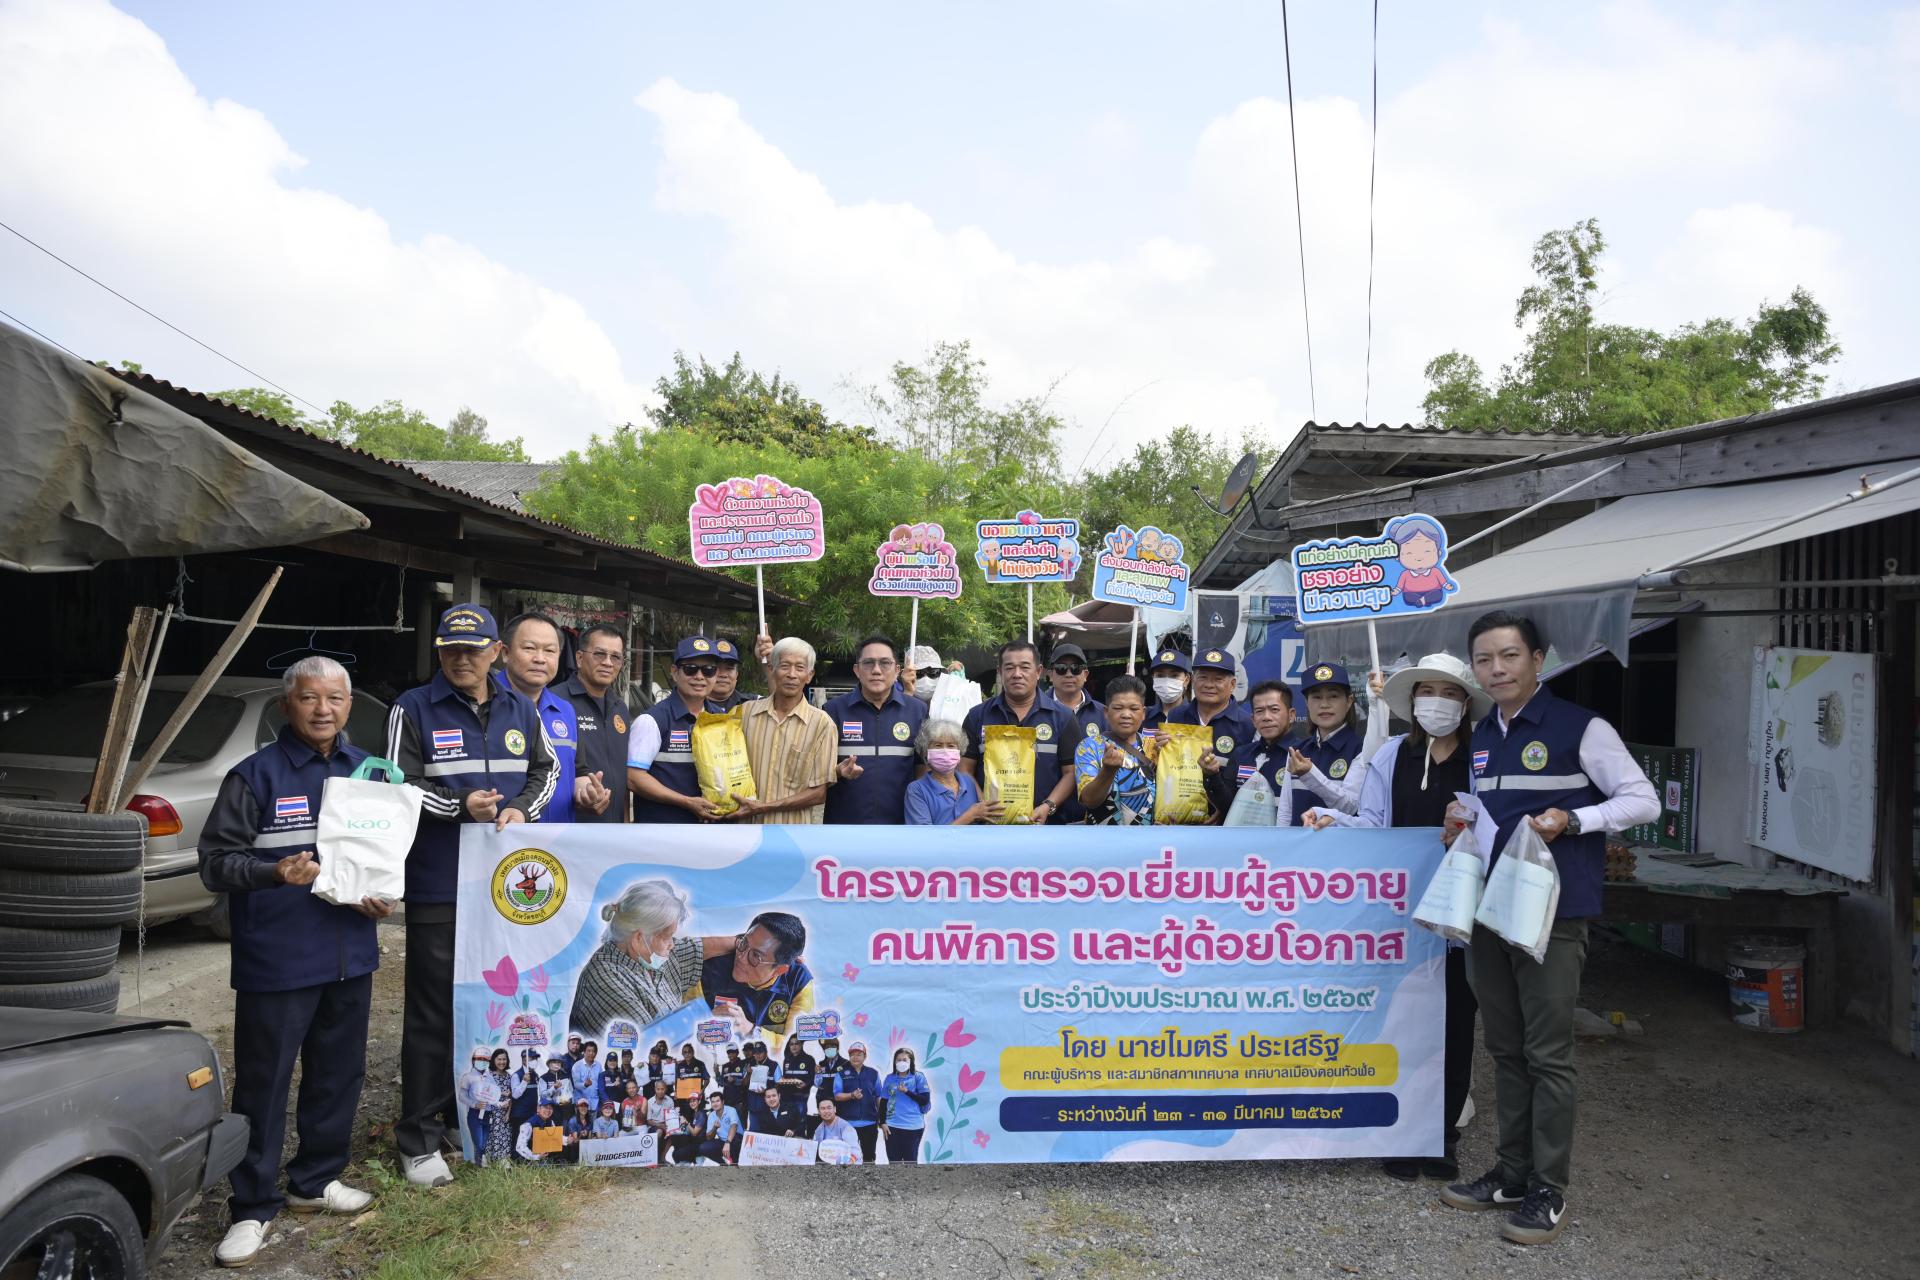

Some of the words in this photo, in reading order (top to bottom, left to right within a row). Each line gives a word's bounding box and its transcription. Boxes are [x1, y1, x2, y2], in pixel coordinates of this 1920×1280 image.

[982, 524, 1074, 539] ขอมอบความสุข
[1002, 541, 1056, 557] และสิ่งดีๆ
[1299, 540, 1398, 564] แก่อย่างมีคุณค่า
[1001, 560, 1059, 577] ให้ผู้สูงวัย
[1303, 565, 1382, 588] ชราอย่าง
[1305, 588, 1390, 611] มีความสุข
[815, 850, 1407, 912] โครงการตรวจเยี่ยมผู้สูงอายุ
[872, 924, 1056, 961] คนพิการ
[1073, 918, 1404, 973] และผู้ด้อยโอกาส
[1024, 985, 1238, 1010] ประจำปีงบประมาณ
[1246, 988, 1295, 1009] พ.ศ.
[1302, 989, 1376, 1009] ๒๕๖๙
[1062, 1030, 1106, 1058] โดย
[1119, 1030, 1228, 1058] นายไมตรี
[1240, 1034, 1340, 1062] ประเสริฐ
[1023, 1067, 1102, 1084] คณะผู้บริหาร
[1107, 1068, 1239, 1080] และสมาชิกสภาเทศบาล
[1057, 1102, 1147, 1122] ระหว่างวันที่
[1153, 1110, 1182, 1121] ๒๓
[1234, 1105, 1285, 1121] มีนาคม
[1291, 1107, 1344, 1119] ๒๕๖๙
[595, 1149, 644, 1162] BRIDGESTONE
